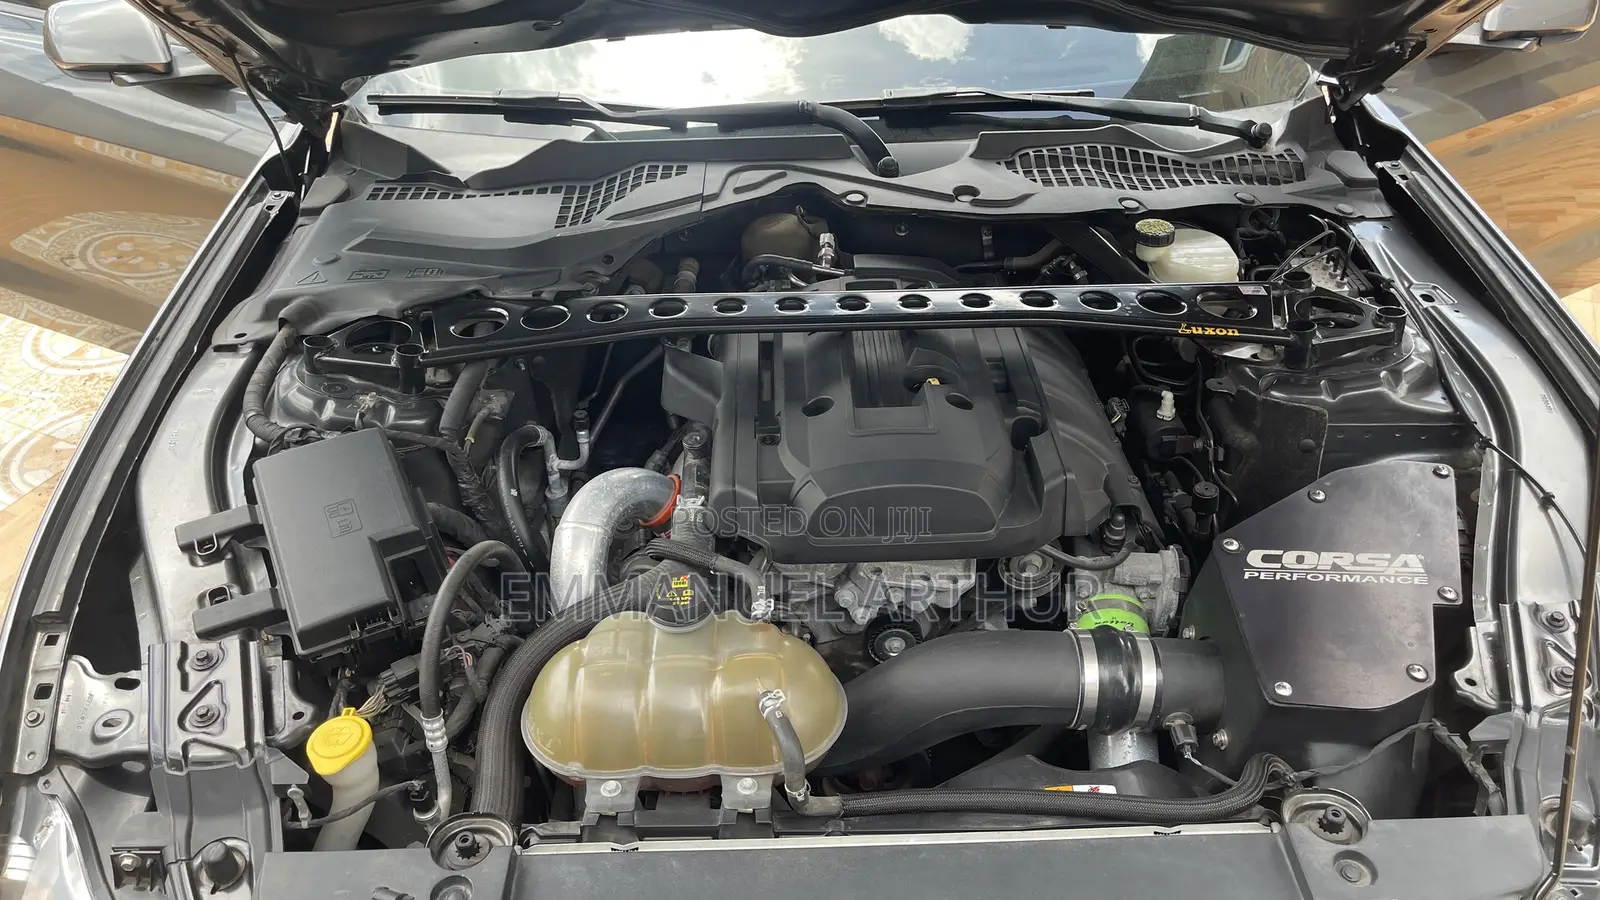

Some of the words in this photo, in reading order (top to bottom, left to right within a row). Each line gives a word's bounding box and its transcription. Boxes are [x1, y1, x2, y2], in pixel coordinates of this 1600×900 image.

[1178, 322, 1240, 336] Luxon
[1246, 549, 1426, 574] CORSA
[1243, 571, 1429, 585] PERFORMANCE
